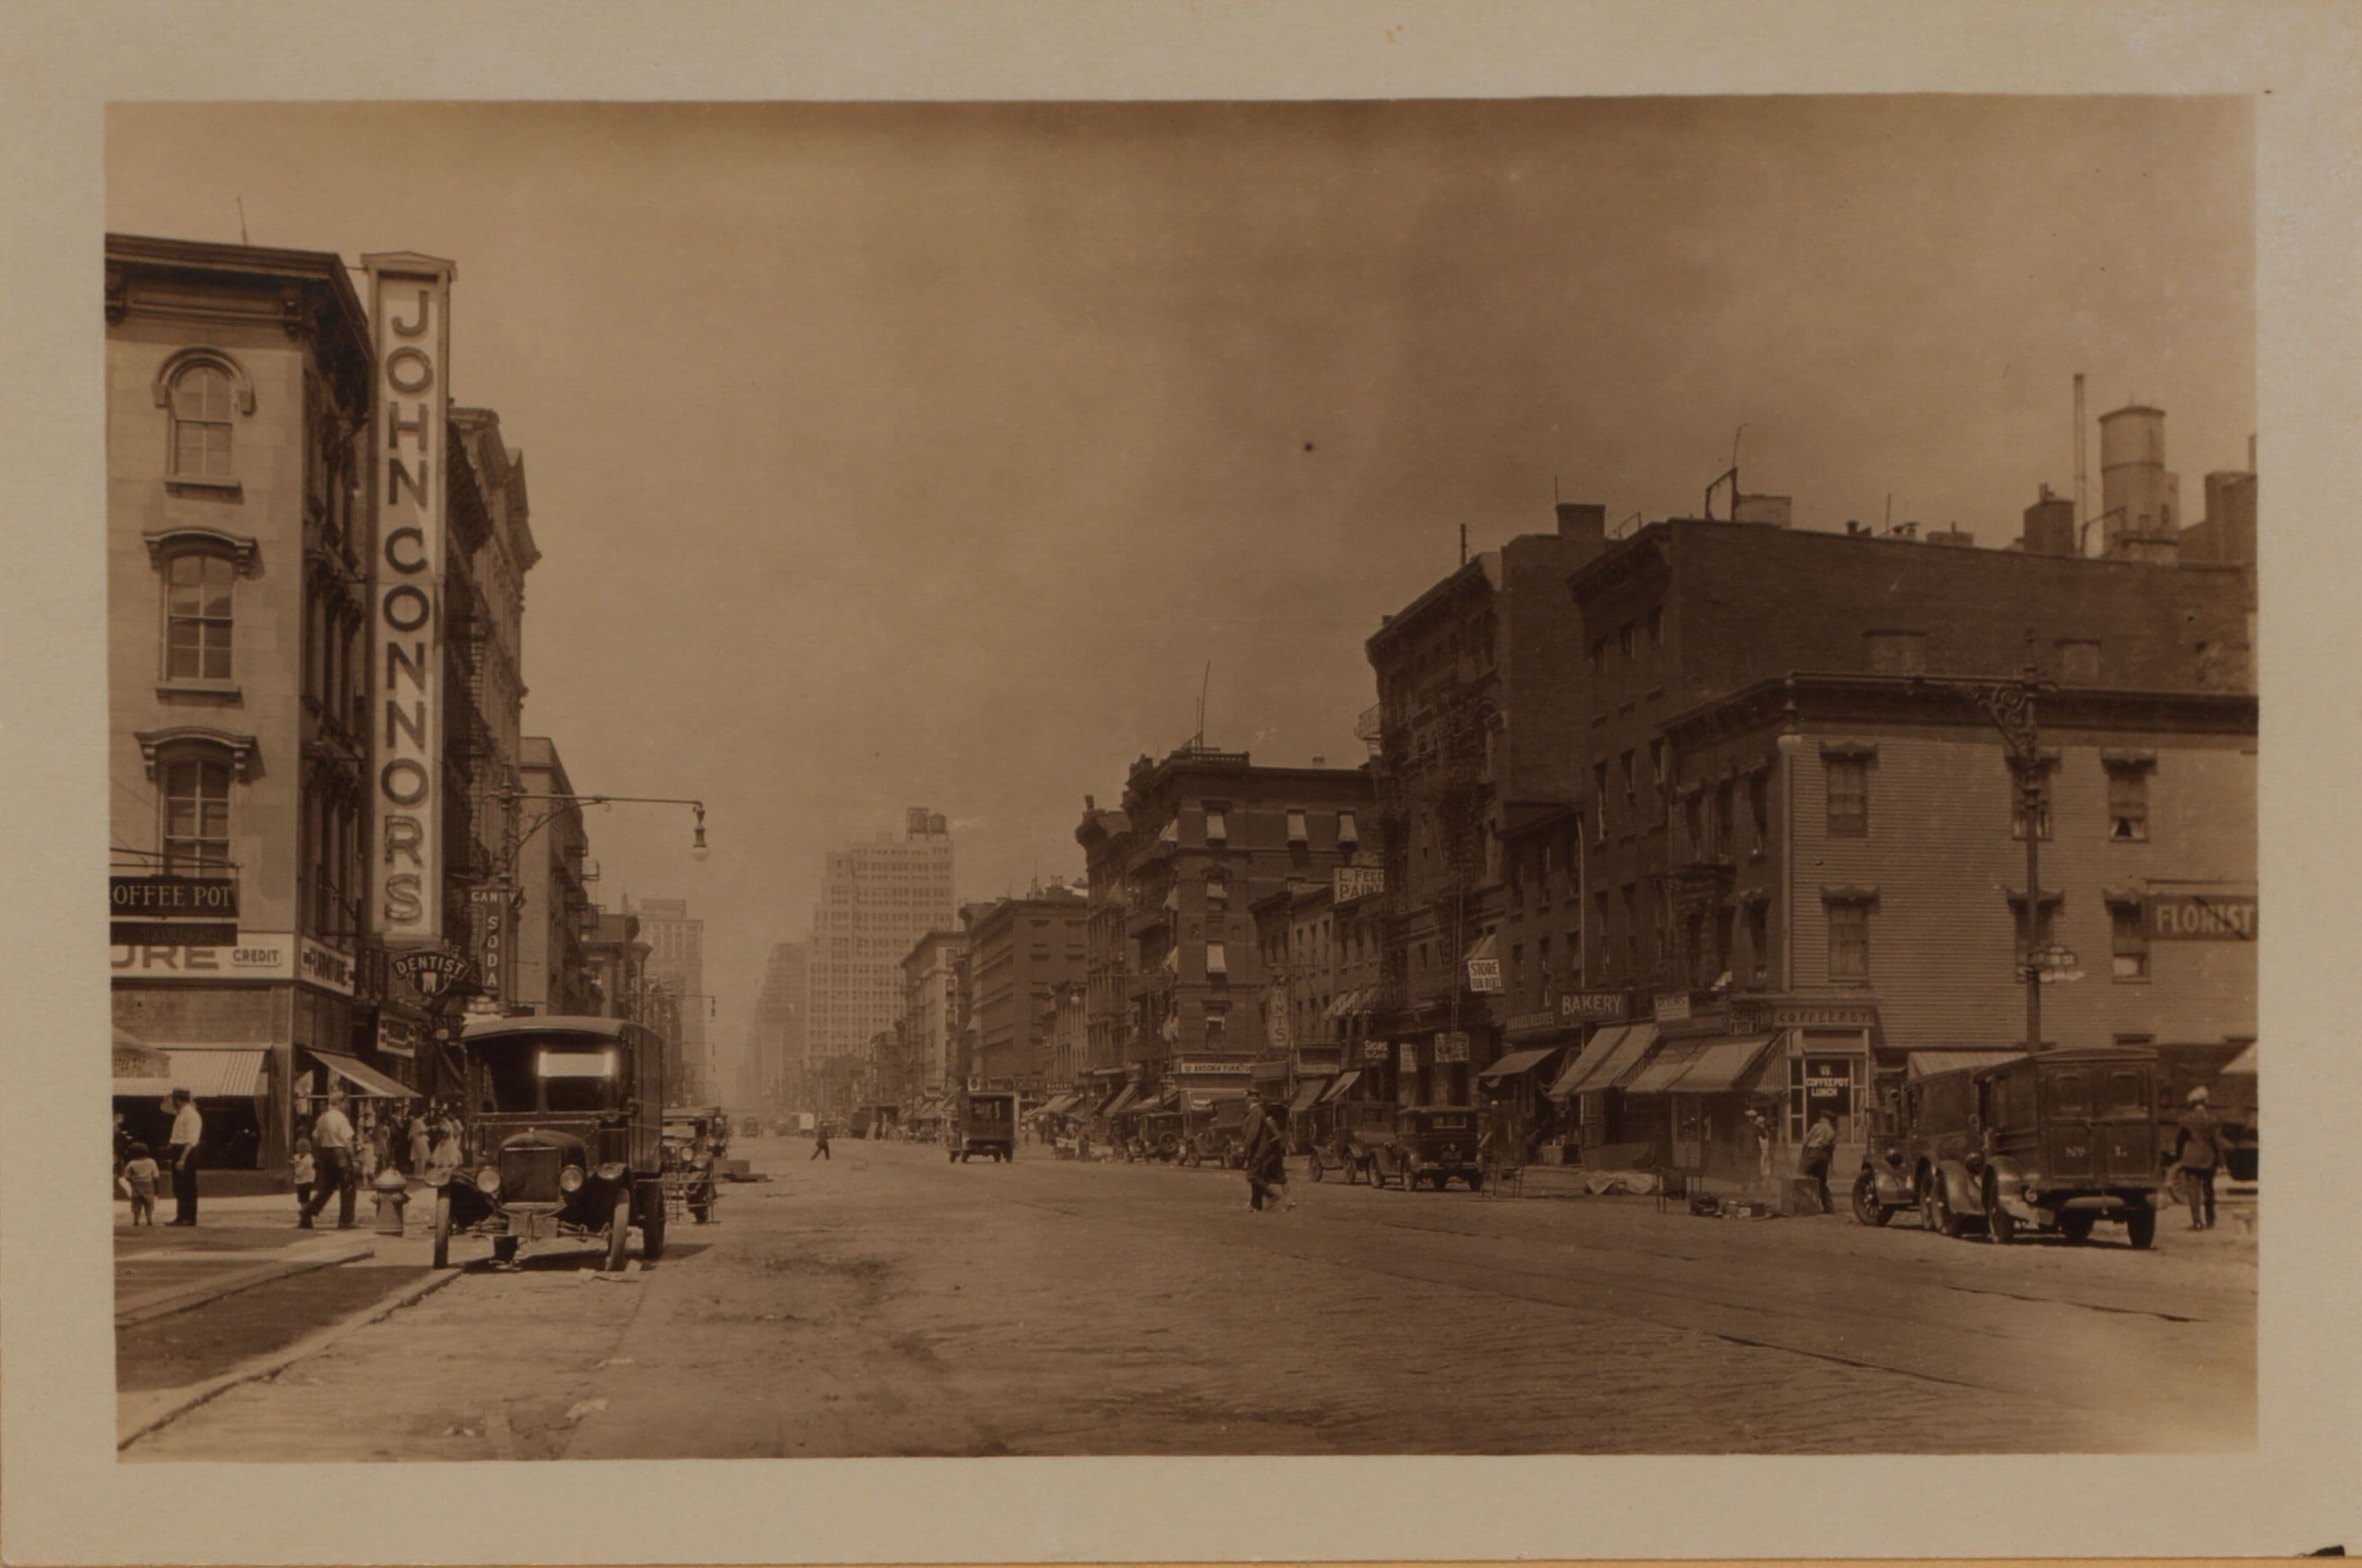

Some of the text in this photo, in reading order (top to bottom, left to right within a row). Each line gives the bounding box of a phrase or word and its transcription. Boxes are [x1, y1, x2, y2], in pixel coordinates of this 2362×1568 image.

[380, 289, 433, 926] JOHN CONNORS
[193, 885, 231, 907] POT
[2156, 904, 2254, 933] FLORIST
[233, 948, 280, 963] CREDIT
[486, 915, 499, 987] SODA
[395, 955, 465, 977] DENTIST
[1471, 962, 1498, 976] STORE
[1562, 994, 1622, 1015] BAKERY
